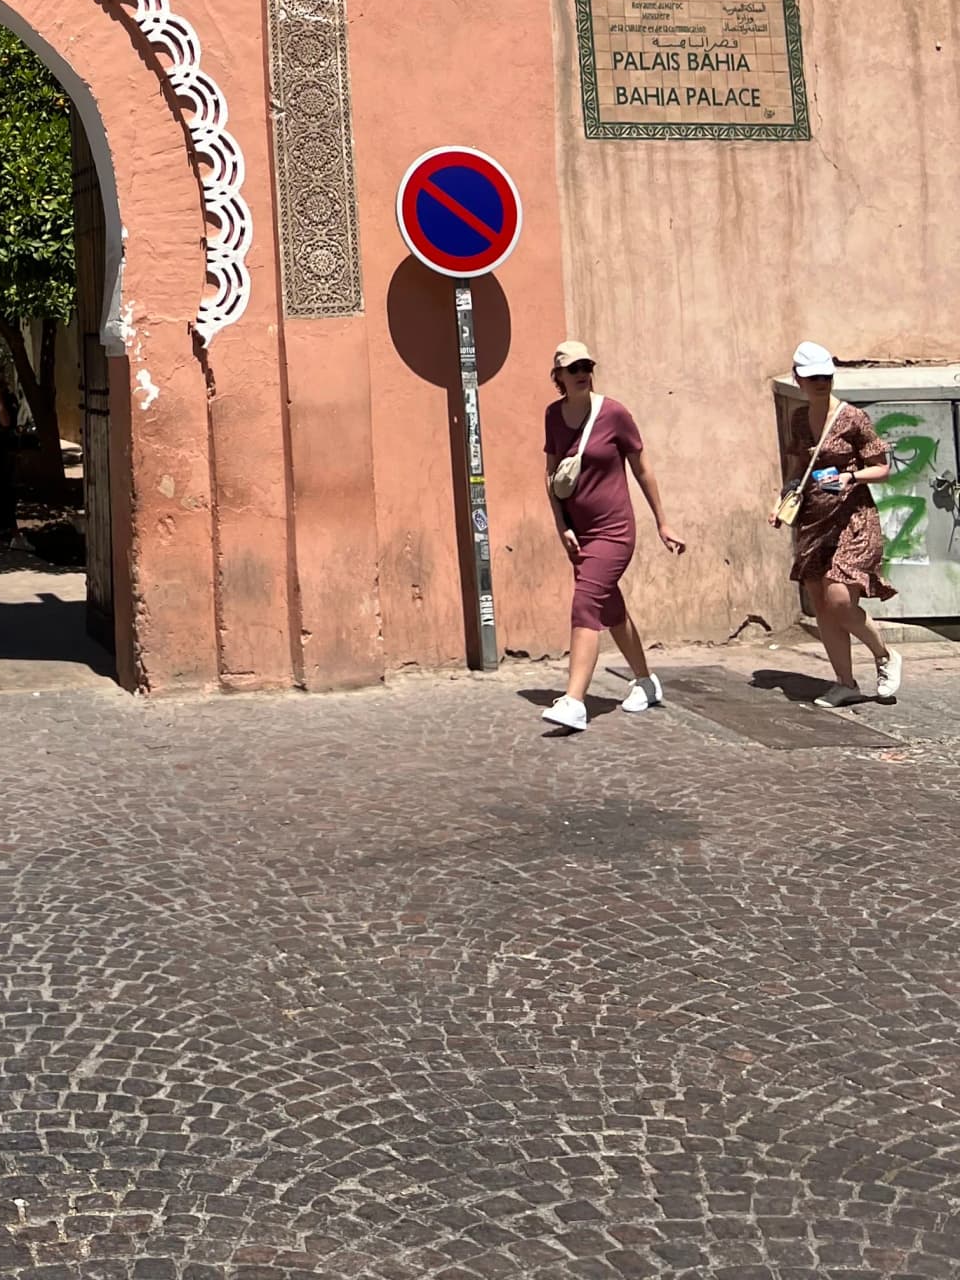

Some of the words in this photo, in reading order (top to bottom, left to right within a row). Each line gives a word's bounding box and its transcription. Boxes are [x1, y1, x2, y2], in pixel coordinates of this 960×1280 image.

[704, 39, 738, 52] قصر
[613, 51, 680, 70] PALAIS
[687, 52, 750, 72] BAHIA
[616, 86, 680, 106] BAHIA
[686, 87, 761, 107] PALACE
